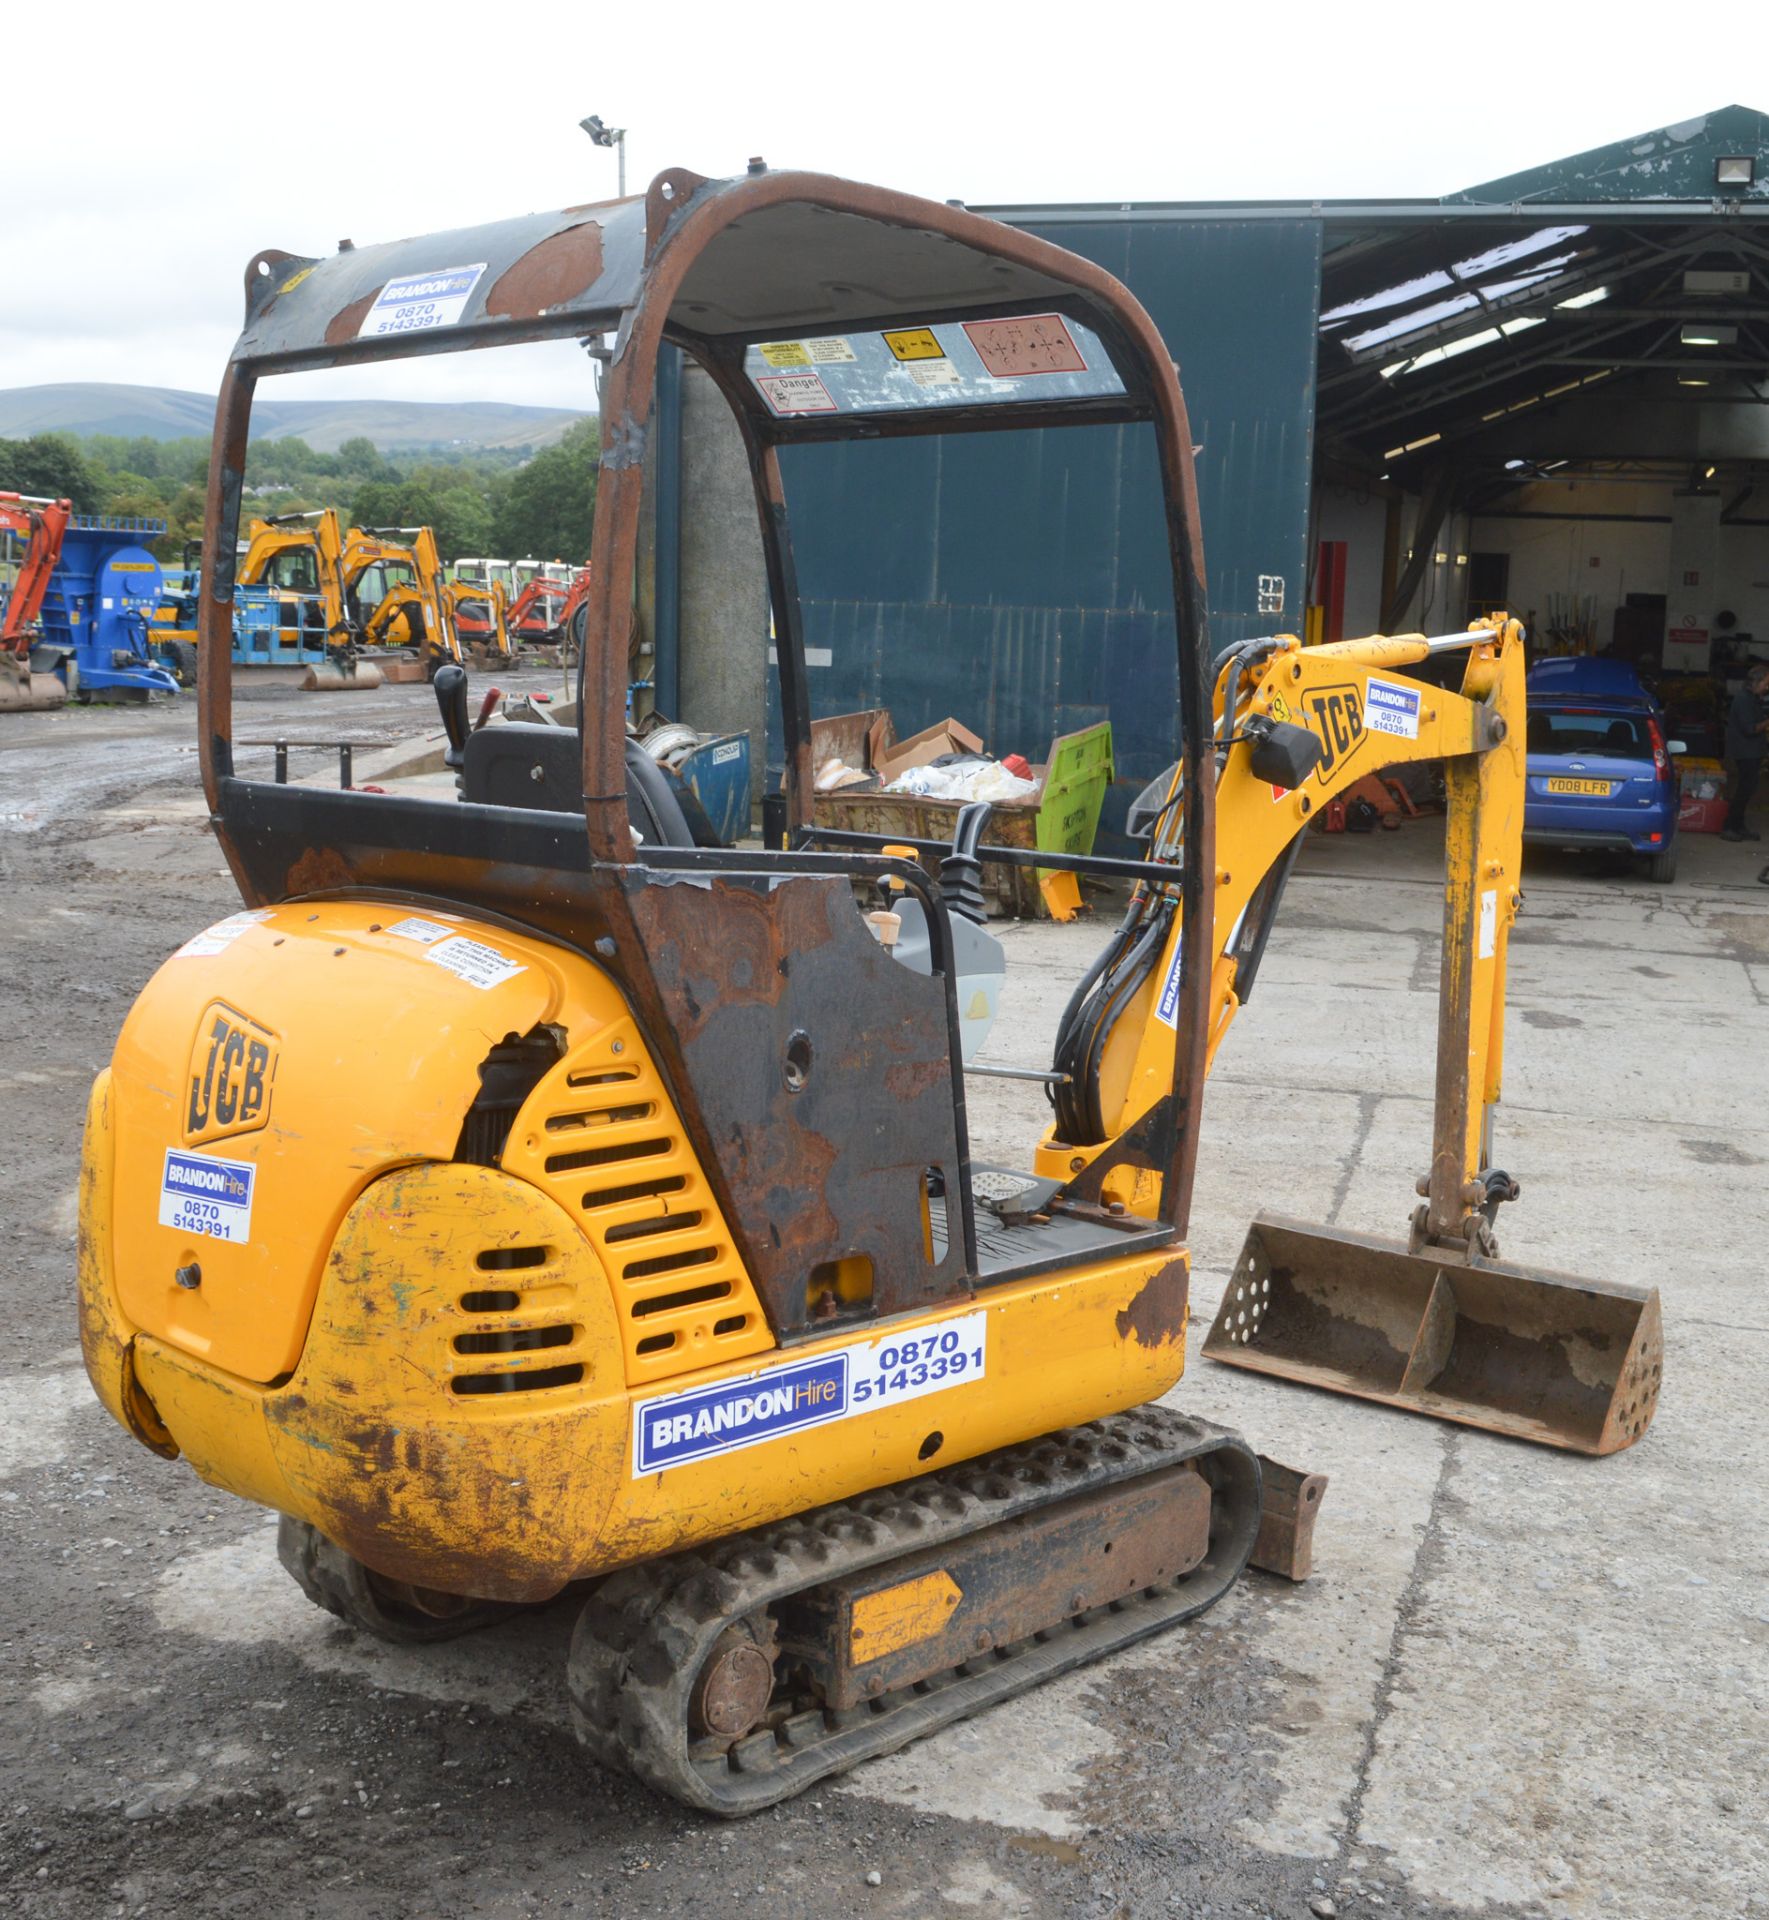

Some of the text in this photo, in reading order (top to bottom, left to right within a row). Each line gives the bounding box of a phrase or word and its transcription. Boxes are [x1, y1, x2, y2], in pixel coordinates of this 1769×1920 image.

[395, 303, 436, 319] 0870
[377, 314, 443, 333] 5143391
[779, 379, 818, 389] Danger
[1381, 711, 1403, 724] 0870
[1312, 693, 1362, 772] JCB
[1373, 721, 1408, 736] 5143391
[1550, 779, 1608, 794] YD08 LFR
[188, 1017, 269, 1132] JCB
[184, 1200, 219, 1220] 0870
[173, 1214, 231, 1238] 5143391
[879, 1331, 960, 1371] 0870
[852, 1347, 984, 1402] 5143391
